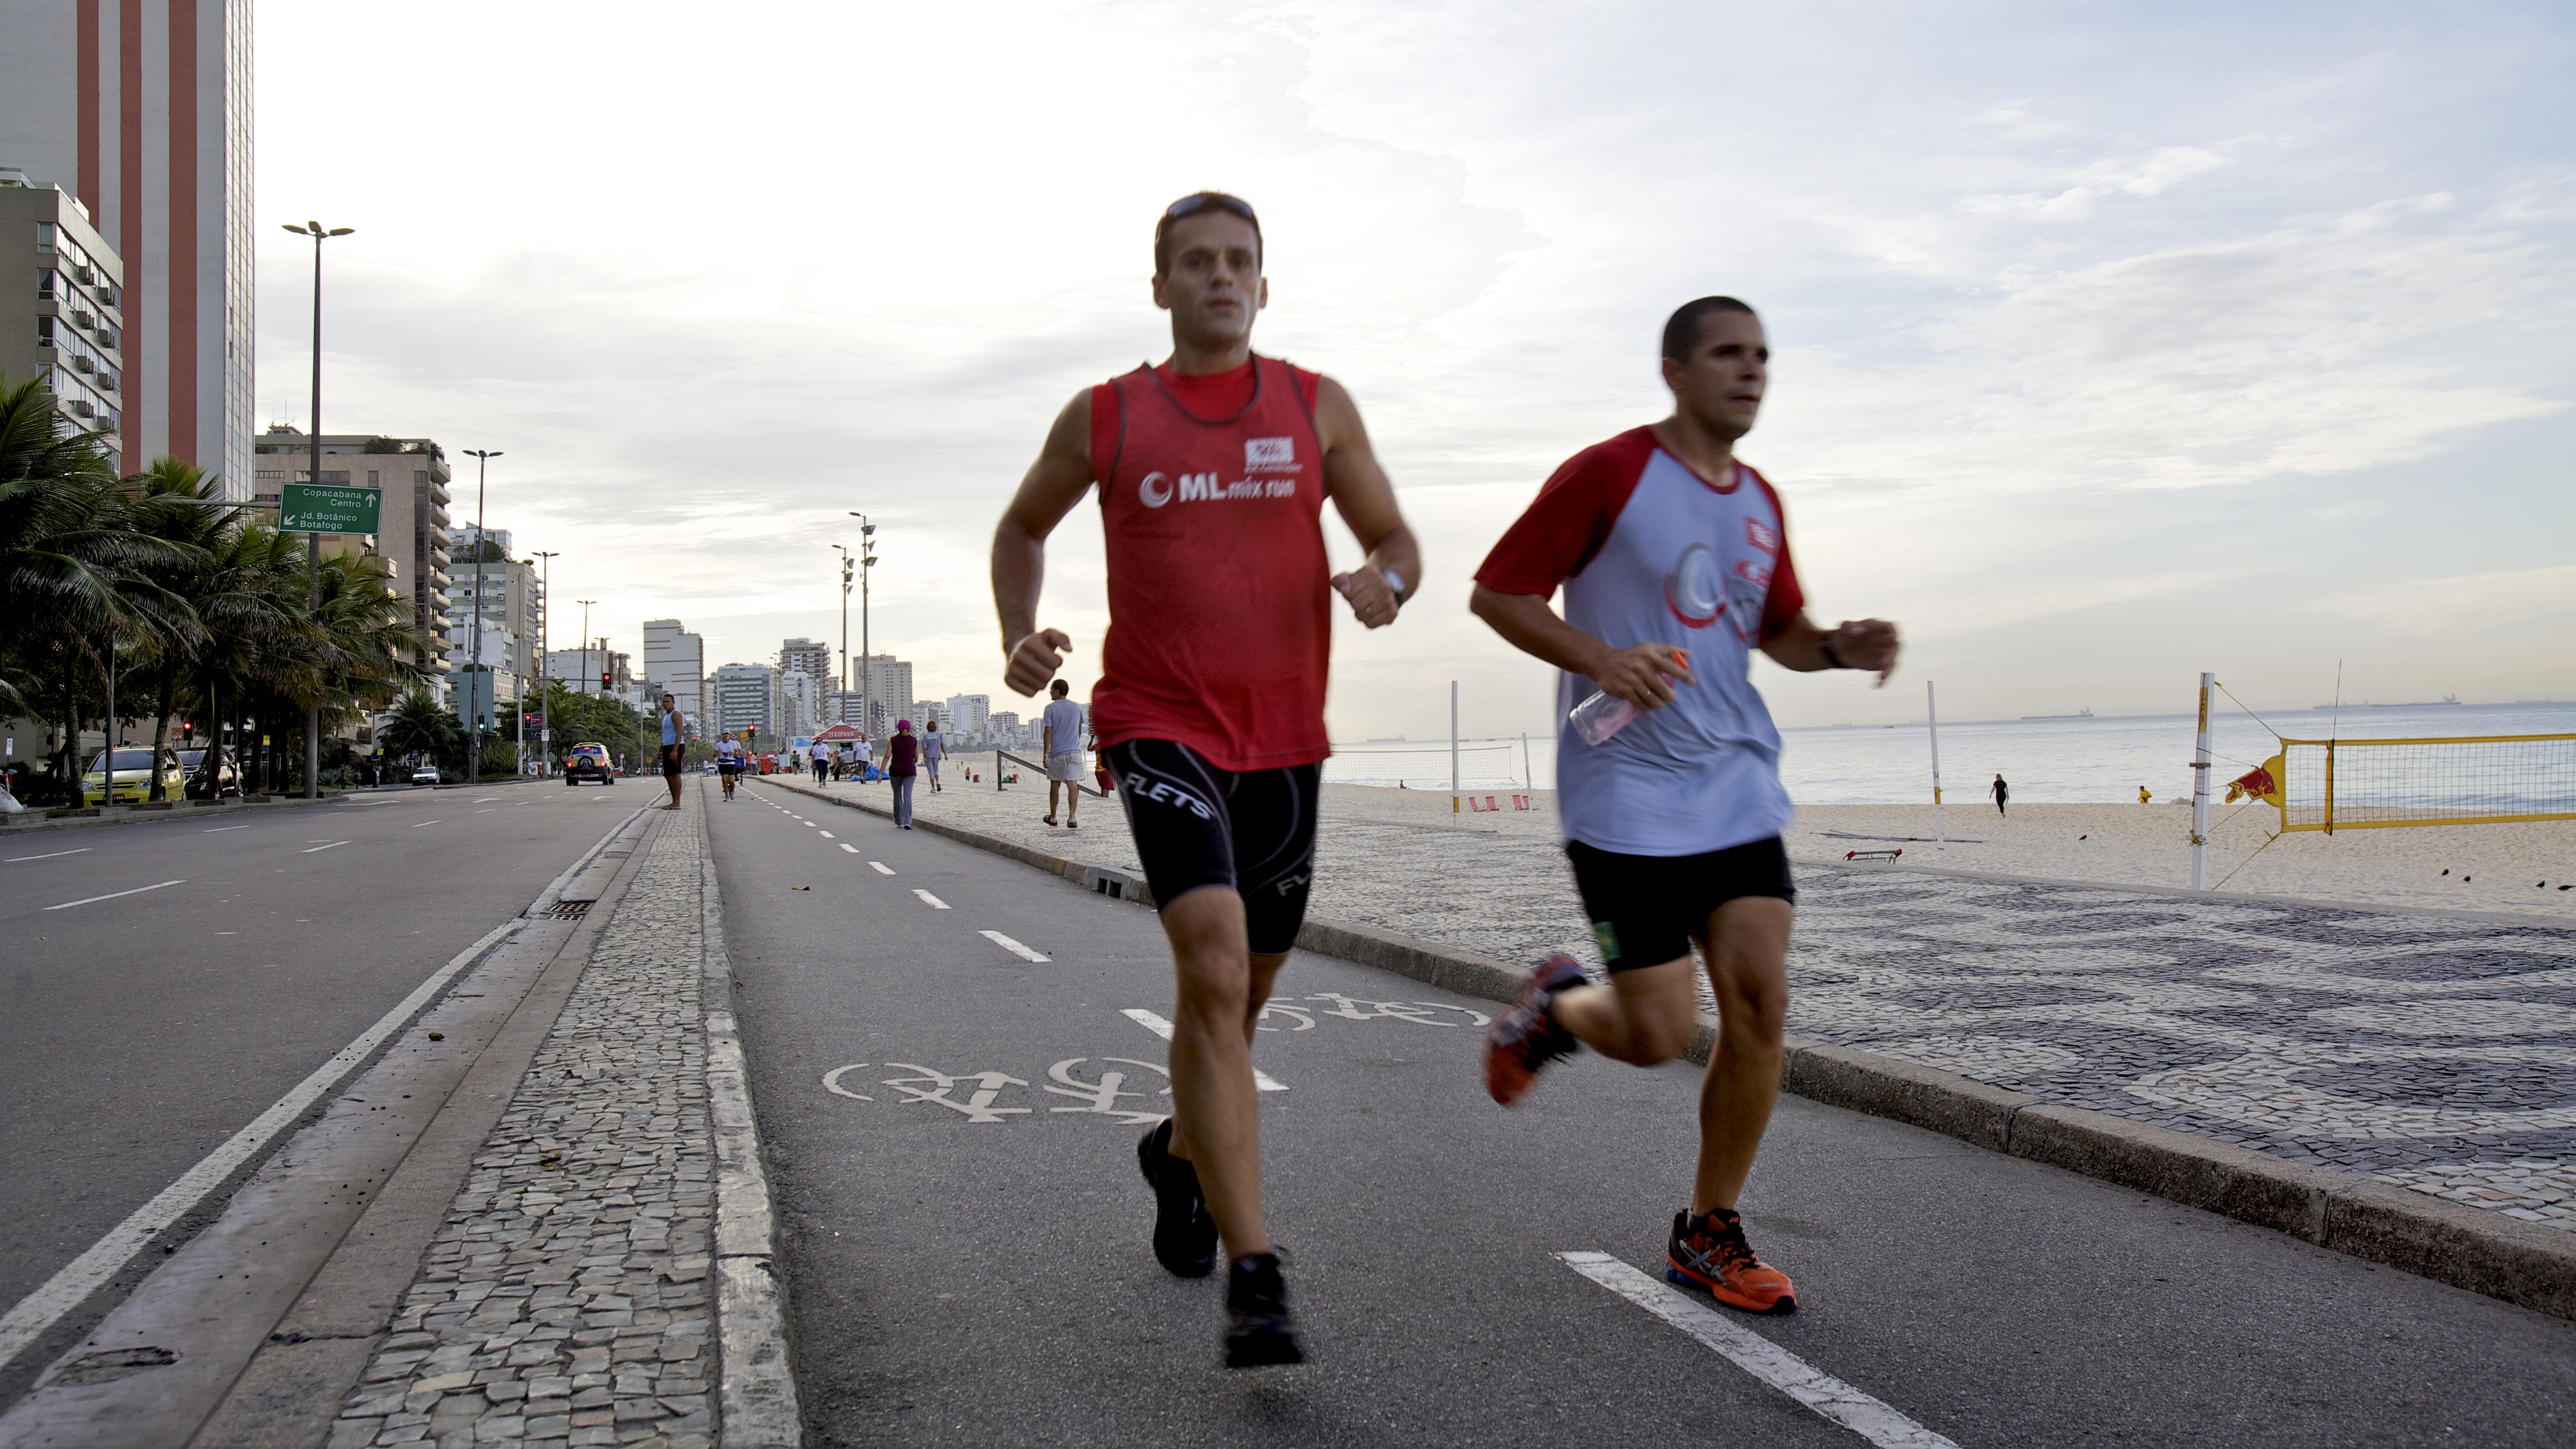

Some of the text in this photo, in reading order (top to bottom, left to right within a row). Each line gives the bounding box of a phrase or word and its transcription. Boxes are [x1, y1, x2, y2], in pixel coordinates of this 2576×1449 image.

[1179, 472, 1227, 502] ML
[303, 488, 361, 499] Copacabana
[330, 499, 361, 507] Centro
[317, 512, 357, 521] Botânico
[300, 520, 343, 530] Botafogo
